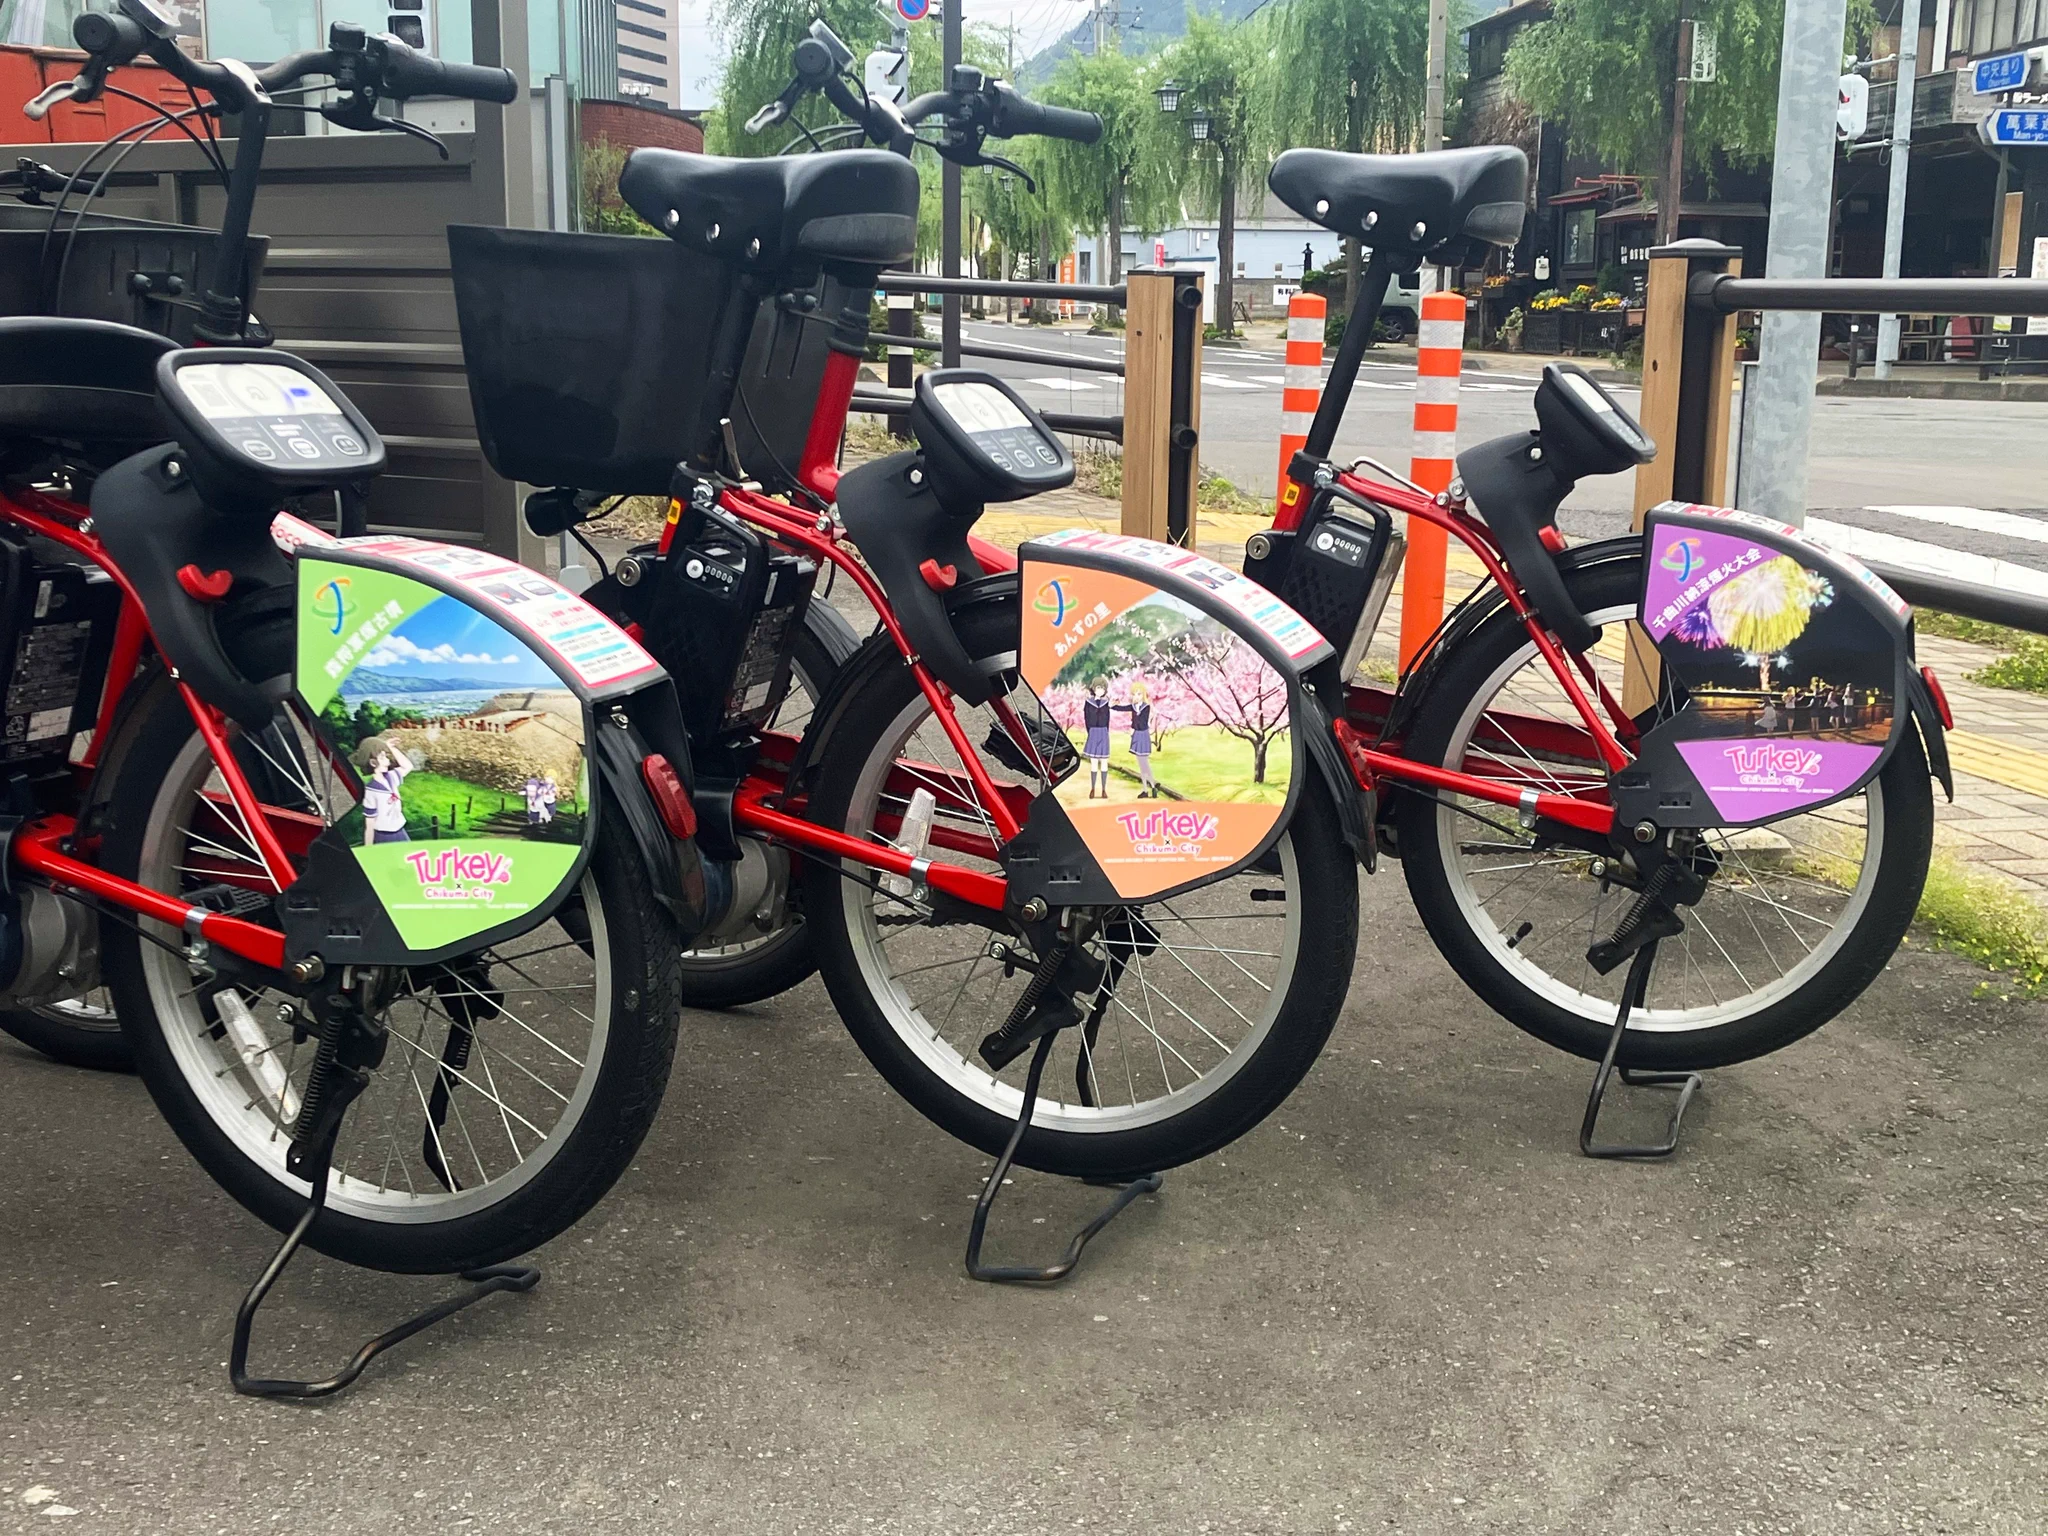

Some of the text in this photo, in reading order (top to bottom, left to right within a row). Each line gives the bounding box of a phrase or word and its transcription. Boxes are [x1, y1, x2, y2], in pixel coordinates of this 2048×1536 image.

[1981, 58, 2020, 79] 中央通り
[1054, 602, 1112, 657] あんずの里
[1783, 775, 1803, 786] City
[1180, 843, 1201, 855] City
[472, 888, 494, 900] City
